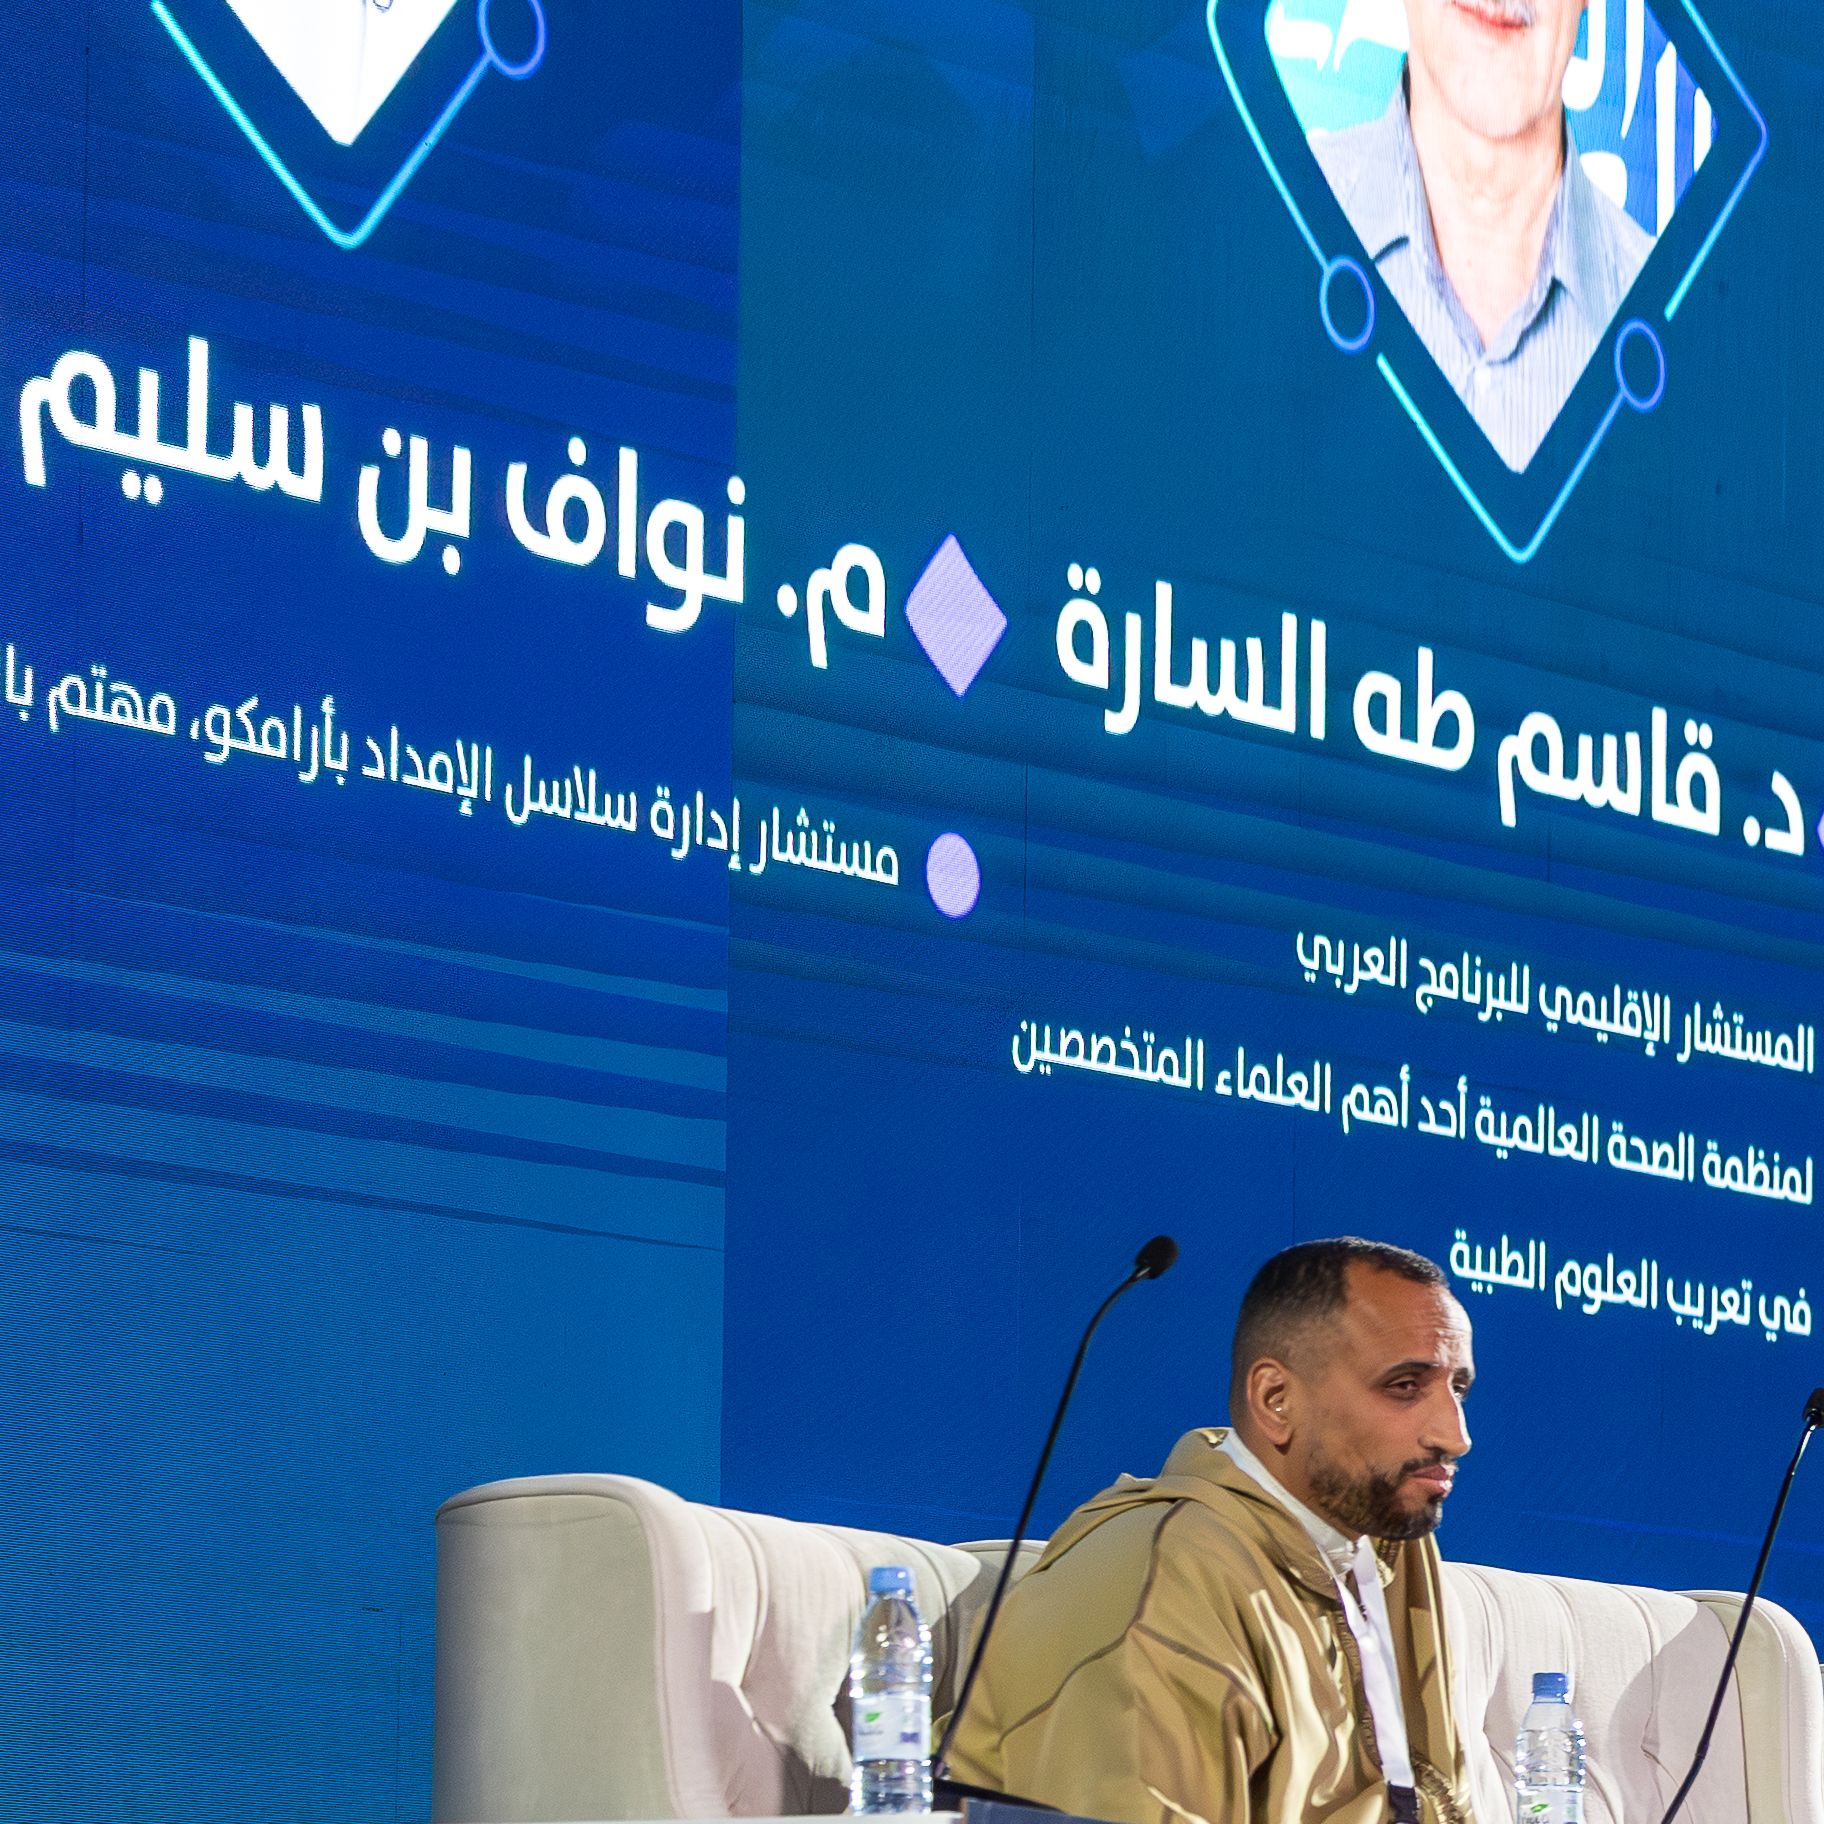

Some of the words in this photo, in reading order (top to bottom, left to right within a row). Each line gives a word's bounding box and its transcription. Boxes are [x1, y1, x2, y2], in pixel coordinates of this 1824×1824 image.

[19, 337, 324, 505] سليم
[358, 428, 471, 575] بن
[506, 437, 745, 633] نواف
[1056, 564, 1326, 739] السارة
[47, 665, 176, 735] مهتم
[1353, 647, 1474, 771] طه
[362, 726, 491, 815] الإمداد
[506, 756, 637, 831] سلاسل
[1498, 707, 1720, 836] قاسم
[651, 786, 741, 869] إدارة
[750, 807, 898, 885] مستشار
[1297, 933, 1407, 993] العربي
[1416, 952, 1529, 1021] للبرنامج
[1539, 984, 1670, 1056] الإقليمي
[1677, 1003, 1813, 1073] المستشار
[1013, 1021, 1203, 1090] المتخصصين
[1215, 1047, 1331, 1113] العلماء
[1342, 1065, 1409, 1133] أهم
[1418, 1076, 1467, 1138] أحد
[1475, 1096, 1598, 1164] العالمية
[1608, 1122, 1694, 1181] الصحة
[1703, 1141, 1812, 1204] لمنظمة
[1450, 1230, 1545, 1294] الطبية
[1555, 1254, 1657, 1314] العلوم
[1667, 1279, 1752, 1334] تعريب
[1759, 1289, 1811, 1341] في
